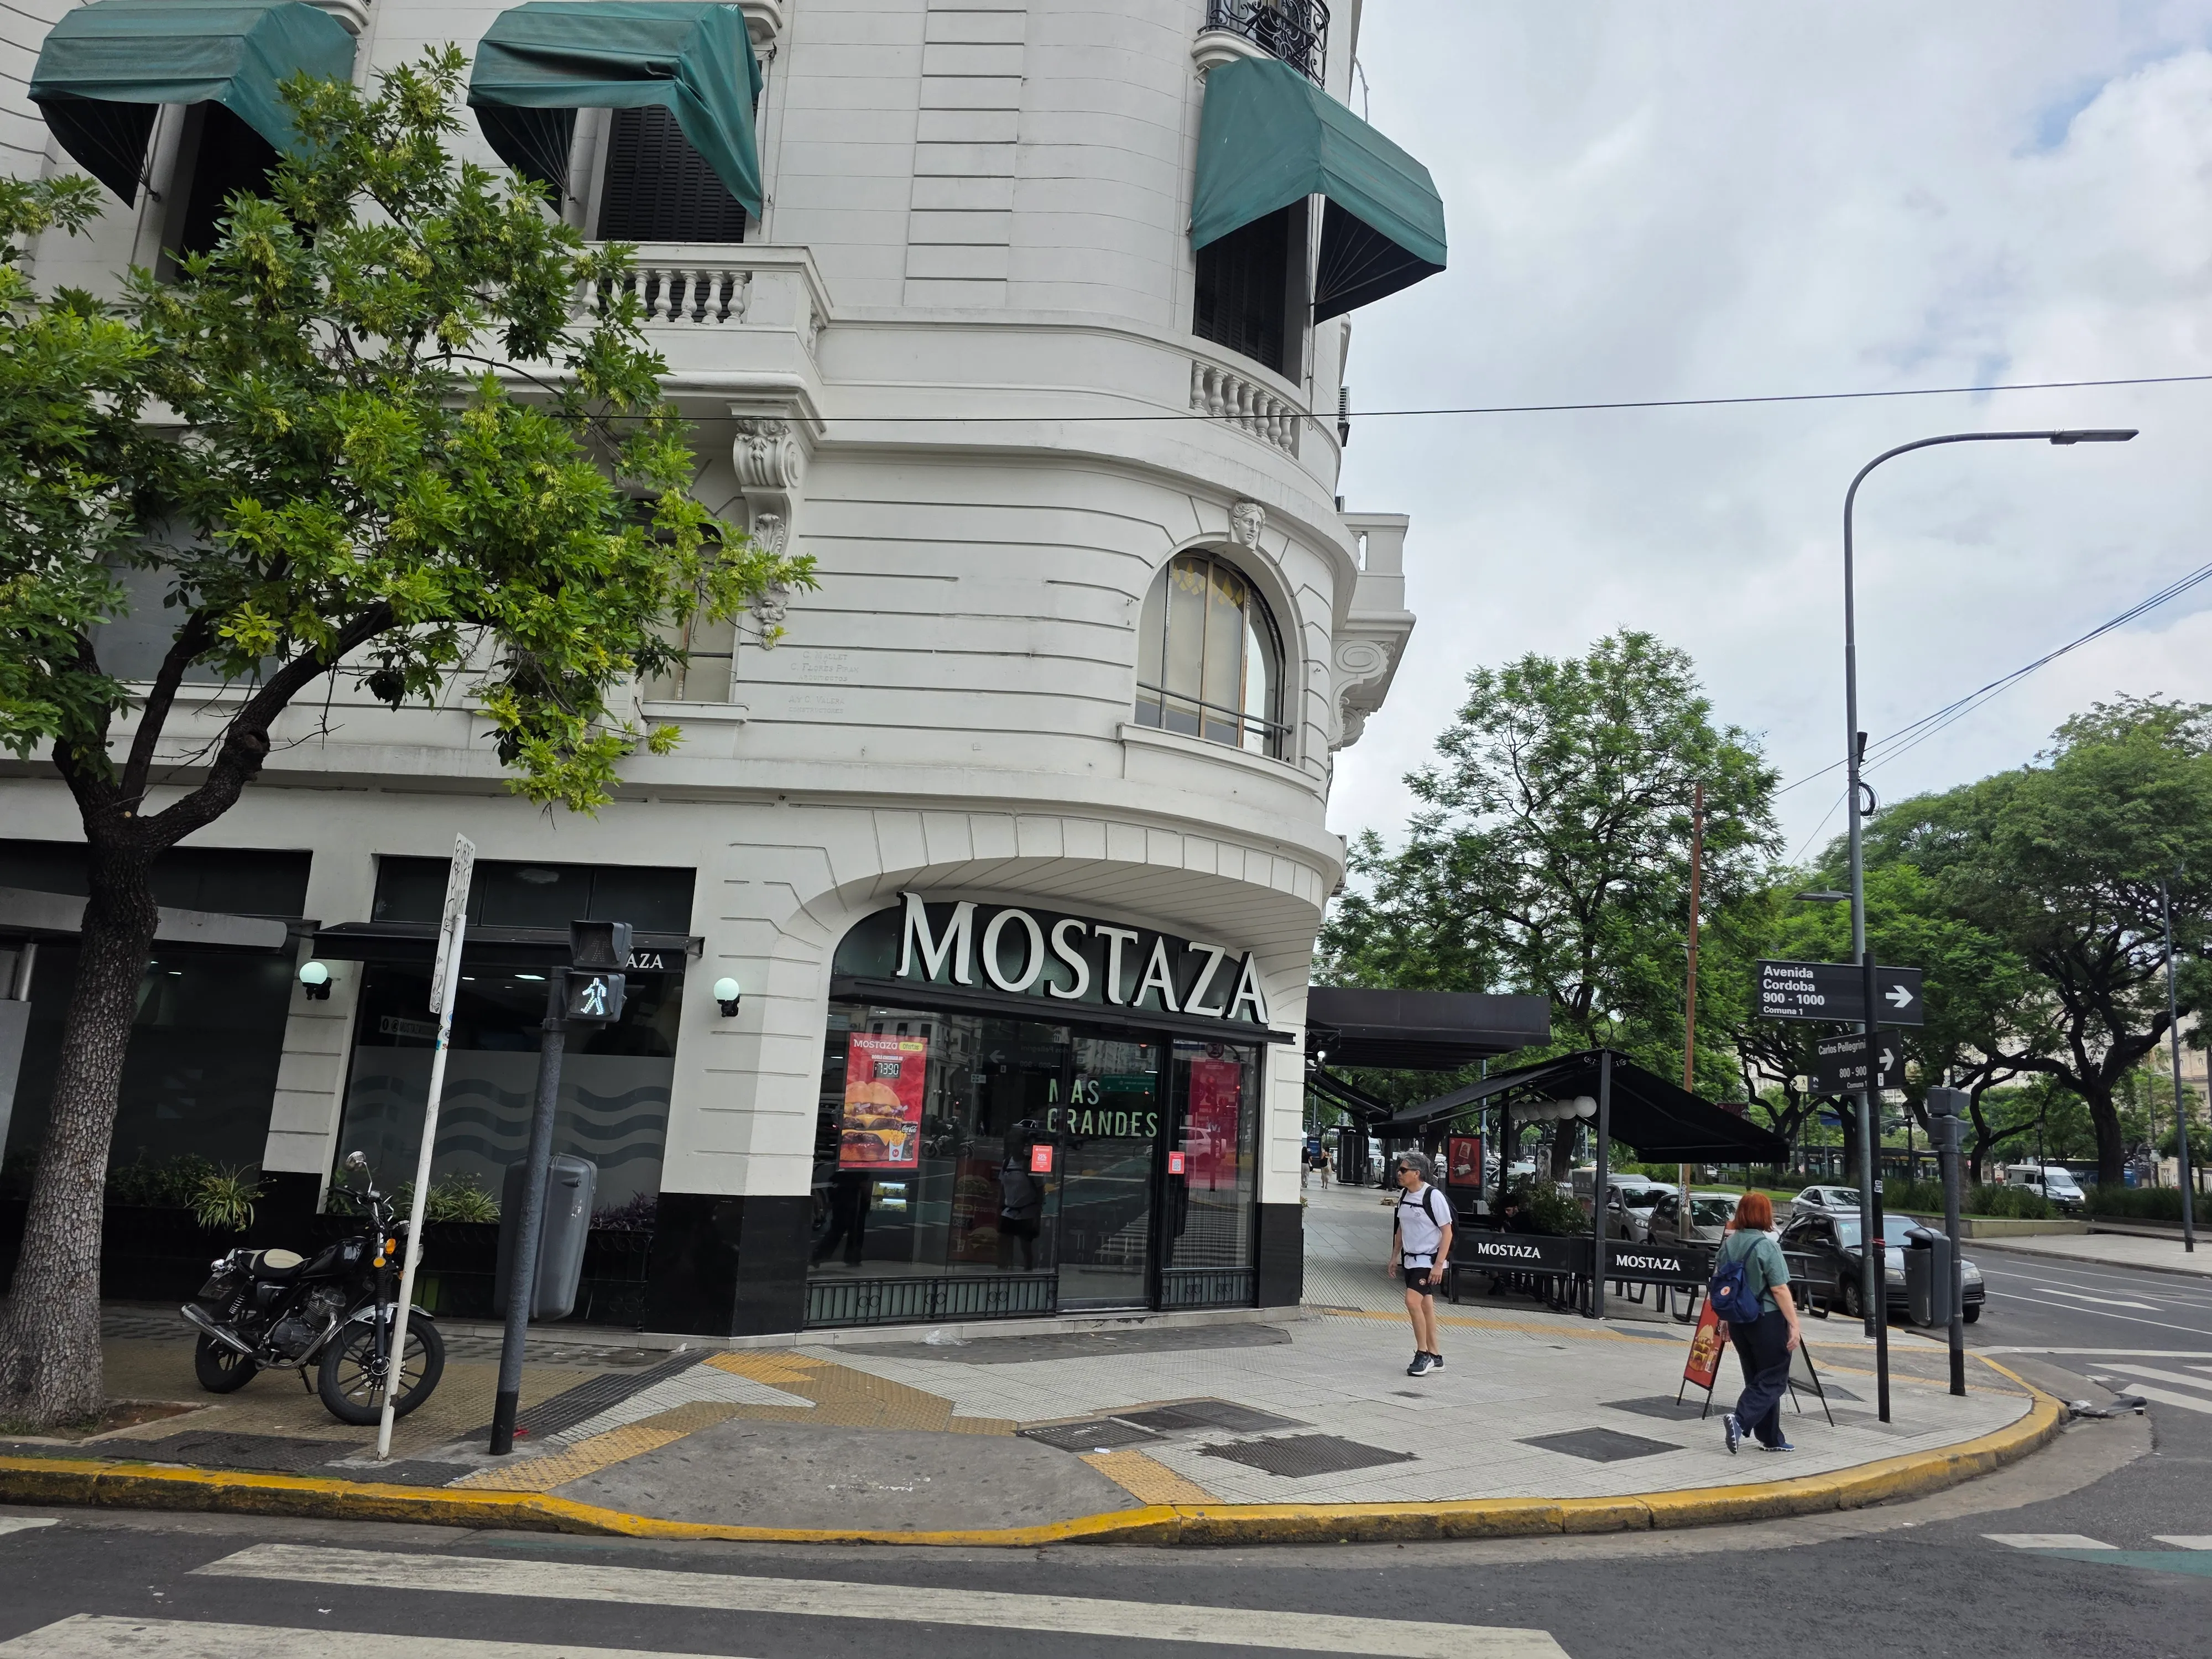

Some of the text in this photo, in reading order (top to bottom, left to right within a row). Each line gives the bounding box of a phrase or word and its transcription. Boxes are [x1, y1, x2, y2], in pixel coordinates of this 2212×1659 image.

[802, 663, 833, 672] FLORES
[893, 891, 1270, 1025] MOSTAZA
[1764, 965, 1814, 978] Avenida
[1763, 978, 1815, 992] Cordoba
[1763, 992, 1785, 1003] 900
[1796, 994, 1825, 1005] 1000
[1763, 1006, 1797, 1015] Comuna
[1818, 1039, 1866, 1055] Carlos Pellegrini
[878, 1062, 899, 1075] 7390
[1839, 1067, 1850, 1078] 800
[1855, 1066, 1867, 1077] 900
[1047, 1108, 1158, 1138] GRANDES
[1478, 1243, 1541, 1259] MOSTAZA
[1616, 1254, 1681, 1271] MOSTAZA
